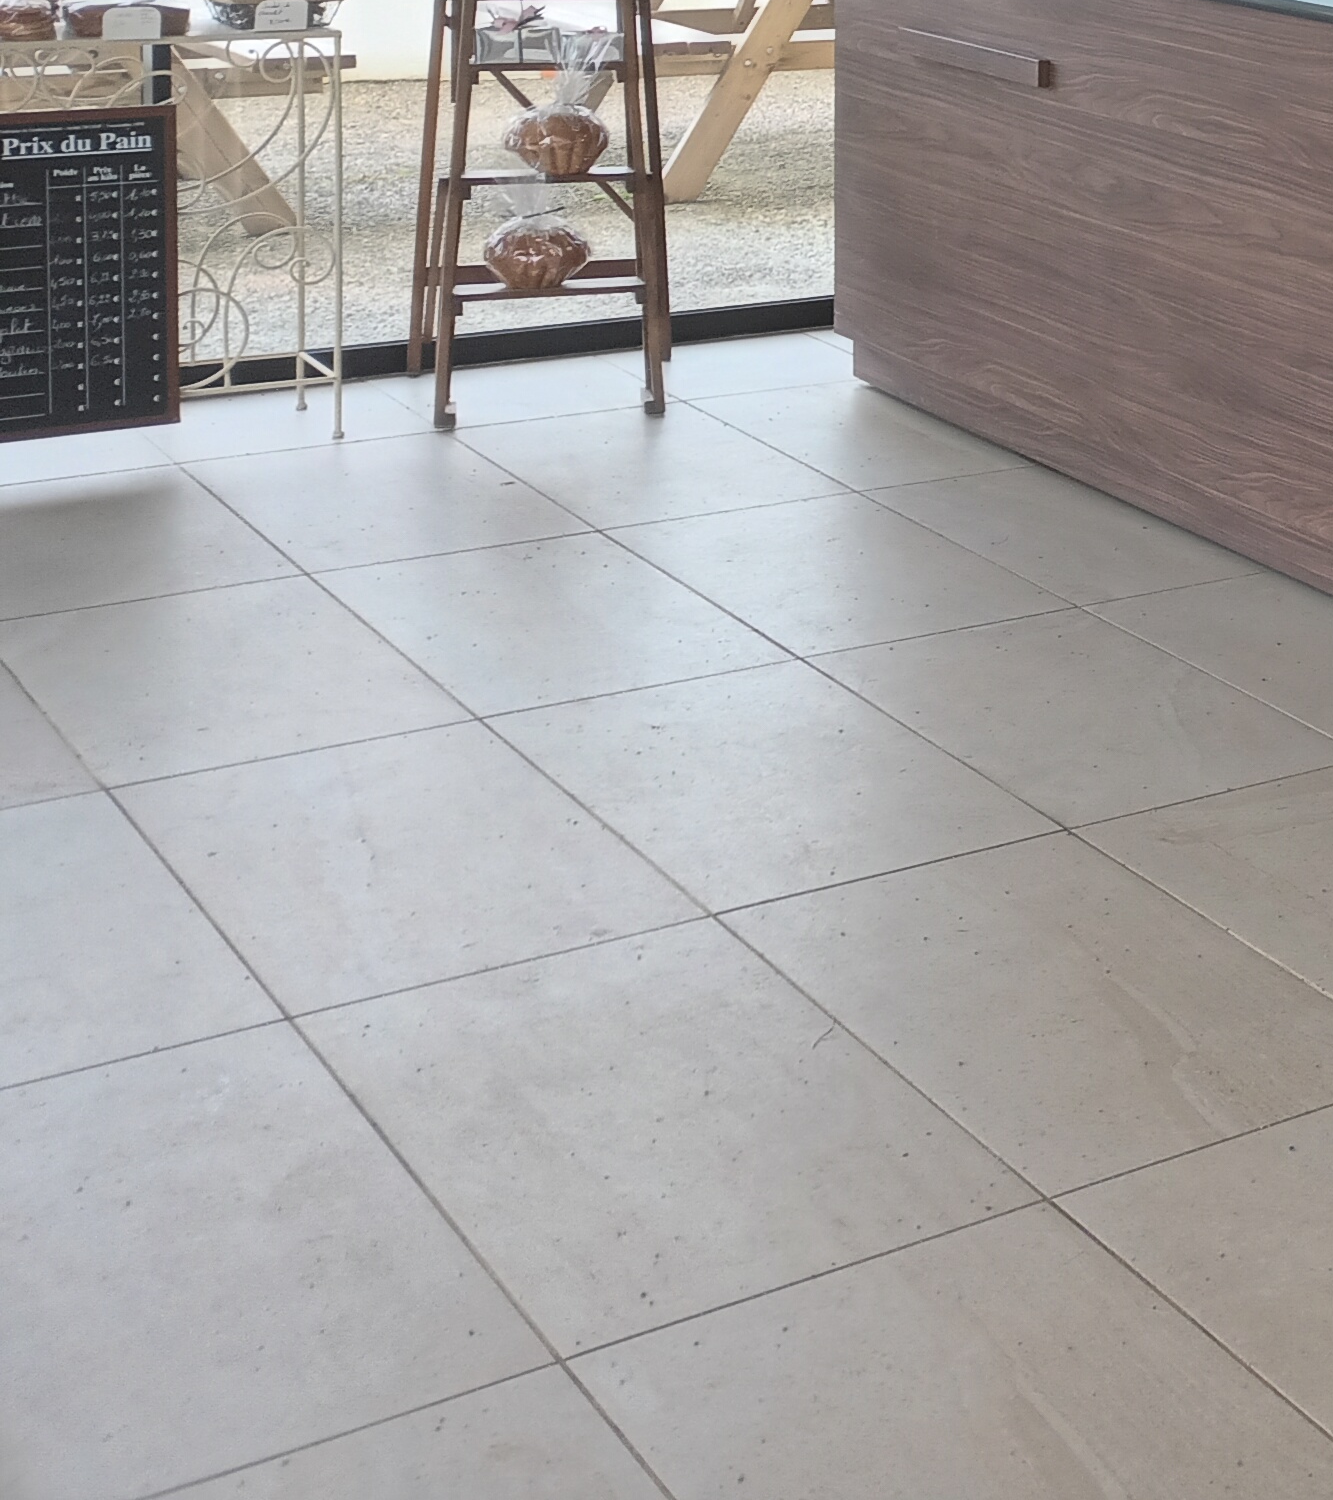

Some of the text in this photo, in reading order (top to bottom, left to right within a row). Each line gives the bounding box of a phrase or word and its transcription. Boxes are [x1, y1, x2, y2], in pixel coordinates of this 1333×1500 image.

[2, 131, 152, 156] Prix du Pain
